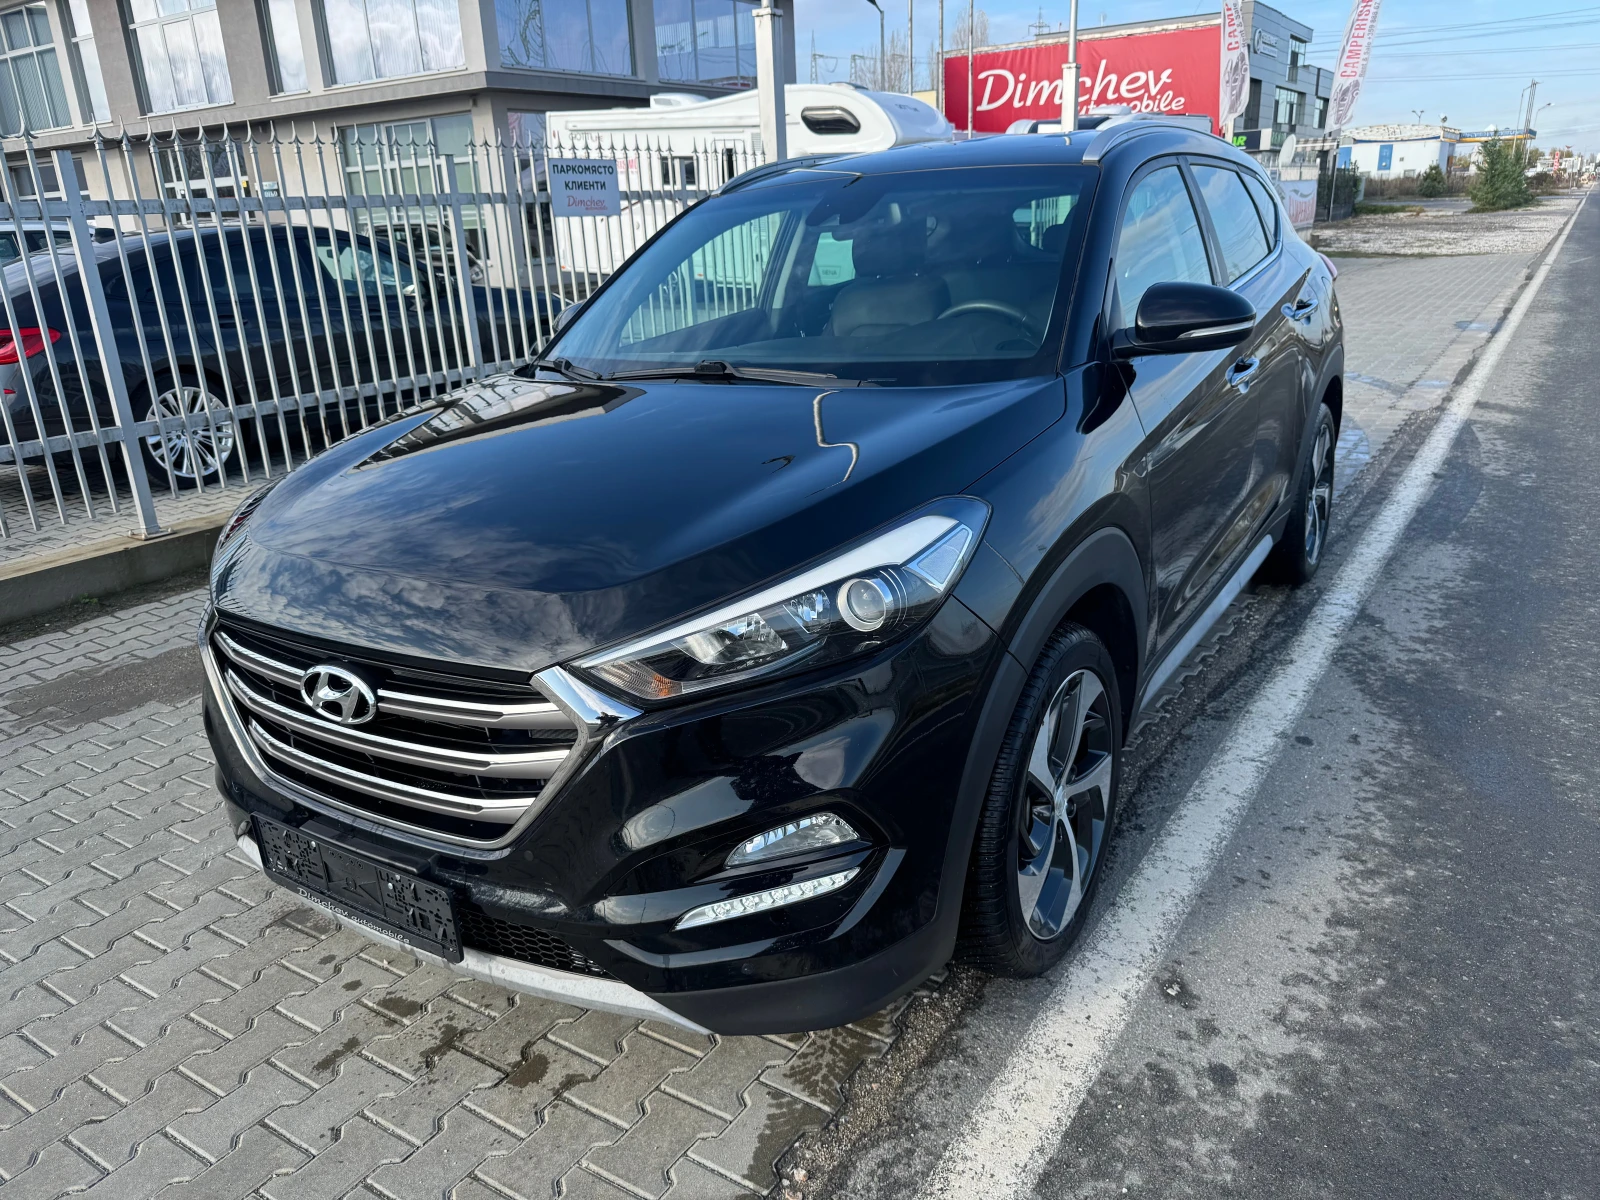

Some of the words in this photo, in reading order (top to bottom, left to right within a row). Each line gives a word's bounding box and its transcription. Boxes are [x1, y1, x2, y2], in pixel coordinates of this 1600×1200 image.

[552, 164, 614, 175] ПАРКОМЯСТО
[564, 180, 607, 191] КЛИЕНТИ
[566, 195, 606, 207] Dimchev
[296, 887, 349, 916] Dimchev
[351, 915, 410, 944] automobile
